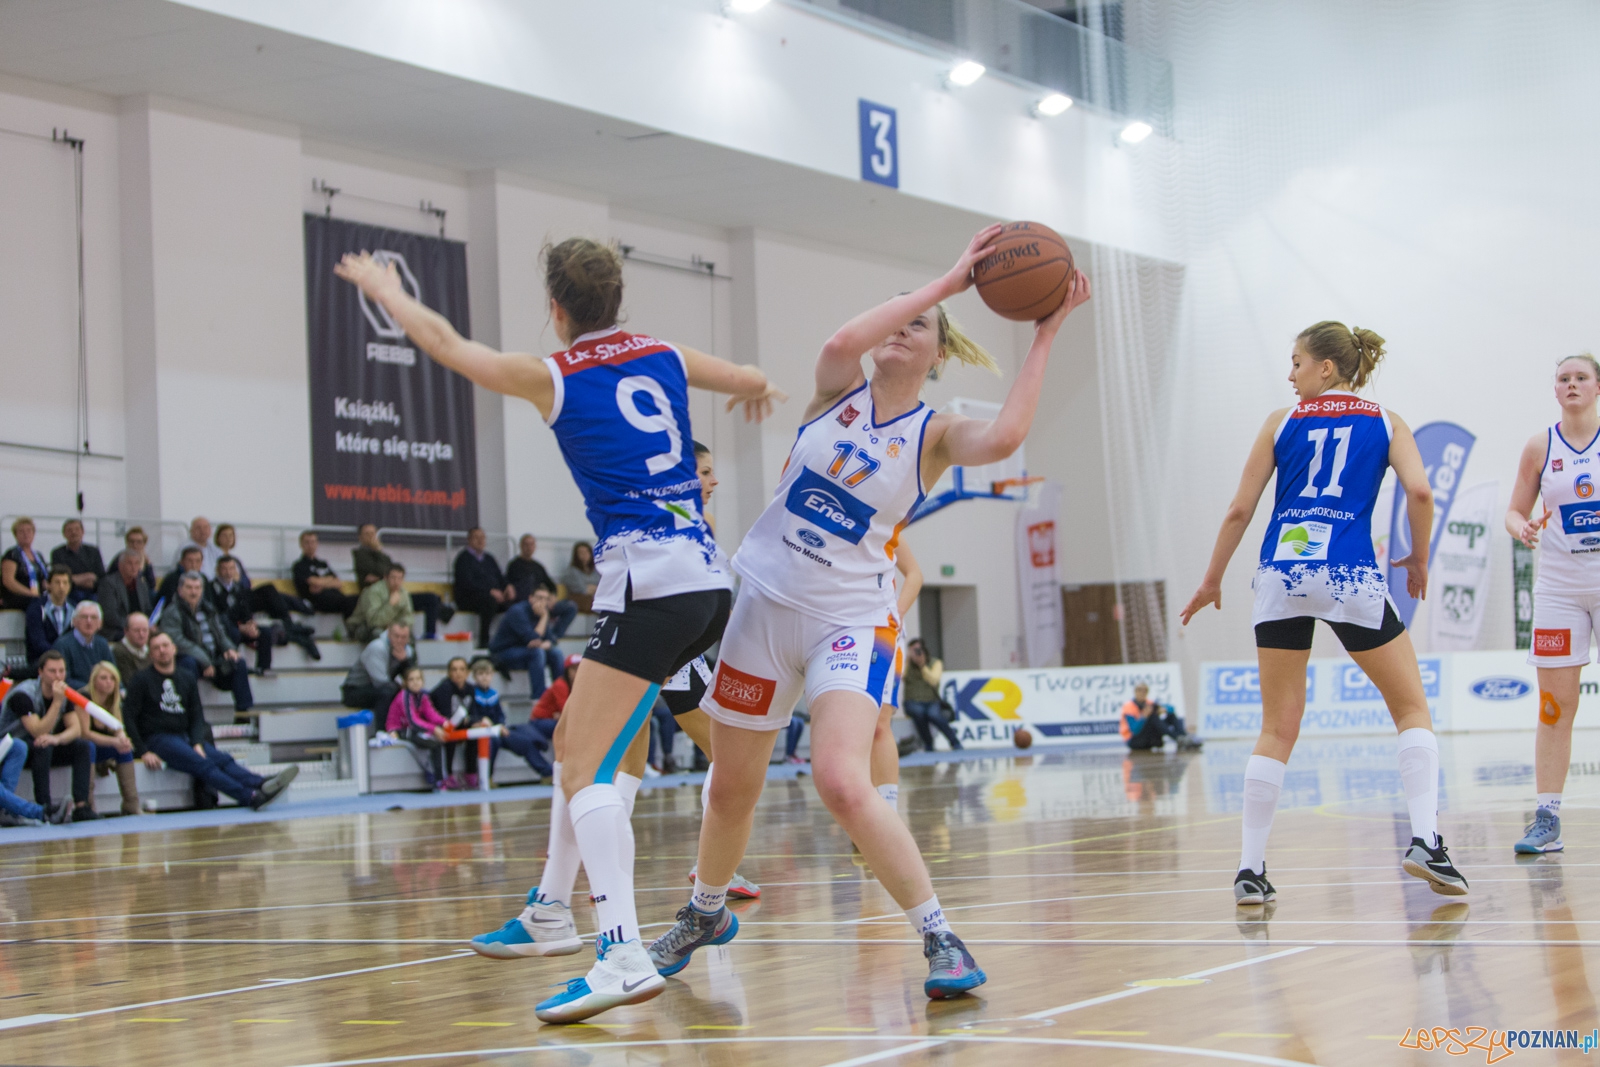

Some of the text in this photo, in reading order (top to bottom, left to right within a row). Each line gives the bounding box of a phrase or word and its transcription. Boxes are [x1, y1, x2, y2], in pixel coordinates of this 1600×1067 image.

[868, 109, 893, 178] 3
[334, 397, 400, 427] Książki,
[616, 374, 682, 476] 9
[335, 431, 454, 464] które się czyta
[1299, 425, 1353, 498] 11
[826, 440, 881, 489] 17
[324, 483, 466, 510] www.rebis.com.pl
[1574, 472, 1595, 499] 6
[804, 494, 856, 530] Enea
[1573, 514, 1600, 526] Ene
[802, 547, 833, 567] Motors
[720, 681, 763, 702] SZPIKU
[1028, 673, 1171, 696] Tworzymy
